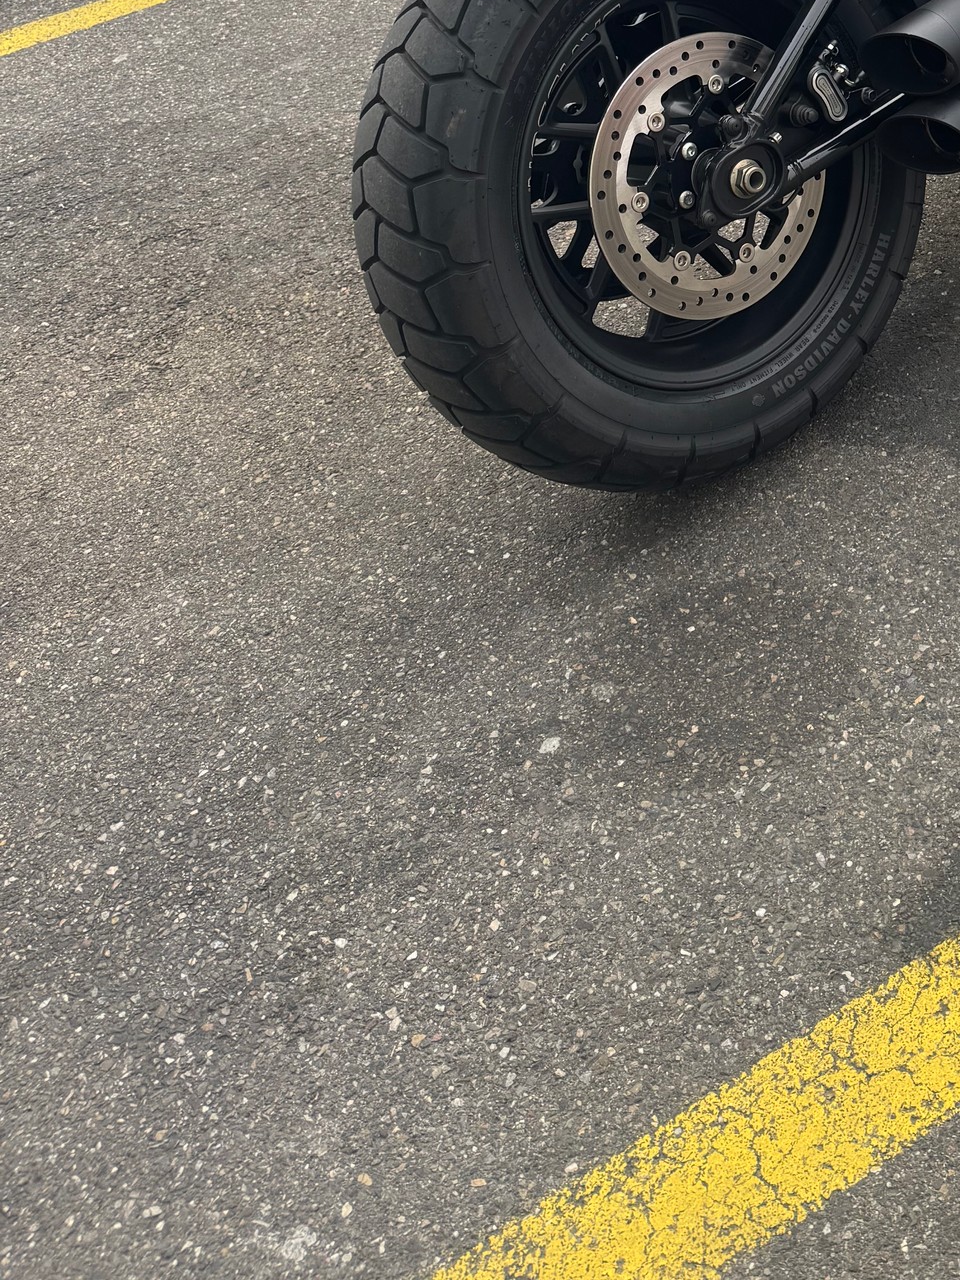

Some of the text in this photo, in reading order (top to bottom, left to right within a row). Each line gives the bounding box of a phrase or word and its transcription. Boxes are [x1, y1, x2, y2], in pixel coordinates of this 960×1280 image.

[793, 336, 810, 352] REAR
[773, 350, 796, 368] WHEEL
[746, 366, 776, 385] FITMENT
